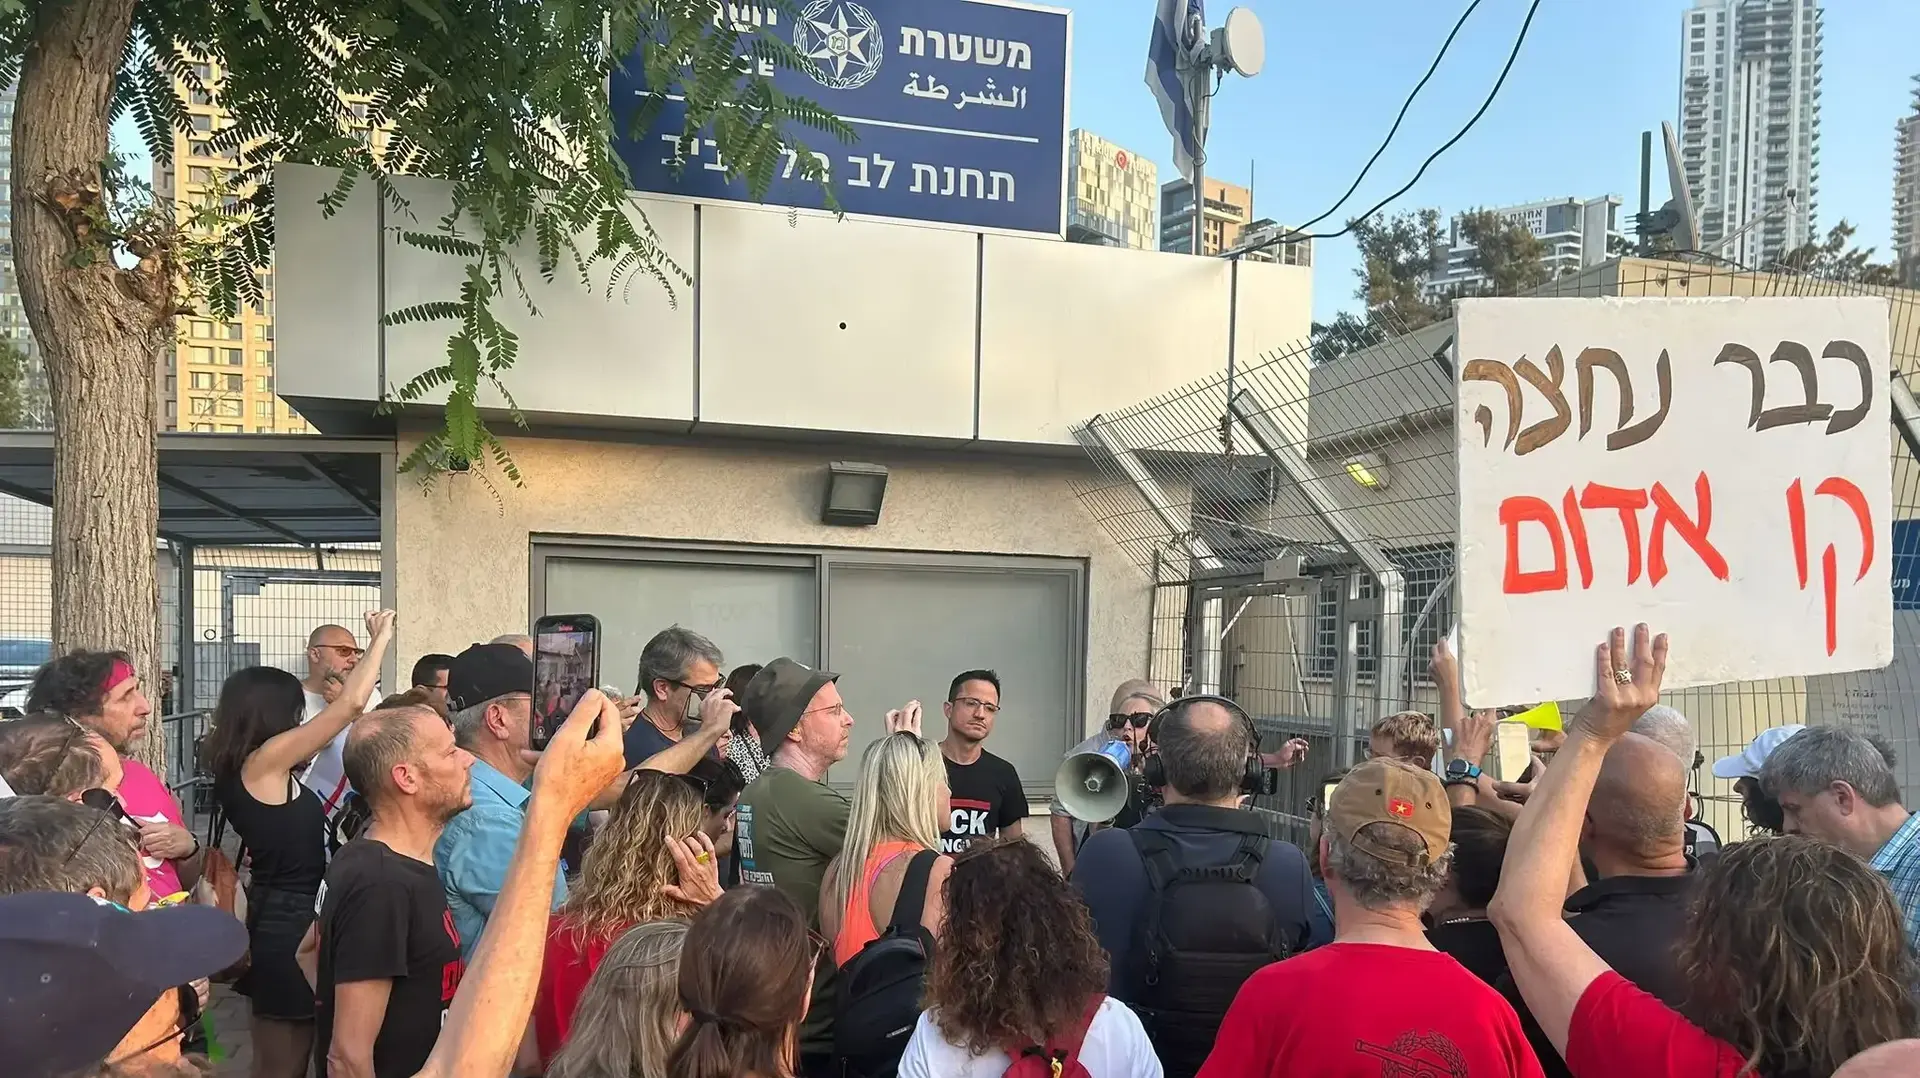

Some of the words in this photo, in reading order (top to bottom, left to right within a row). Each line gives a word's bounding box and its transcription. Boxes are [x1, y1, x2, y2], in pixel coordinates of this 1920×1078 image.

[899, 26, 1032, 70] משטרת
[902, 71, 1027, 110] الشرطة
[661, 133, 760, 177] ביב
[847, 153, 896, 189] לב
[909, 162, 1015, 202] תחנת
[1461, 342, 1673, 456] נחצה
[1713, 339, 1874, 435] כבר
[1498, 469, 1729, 595] אדום
[1785, 476, 1875, 657] קו
[949, 808, 989, 835] CK
